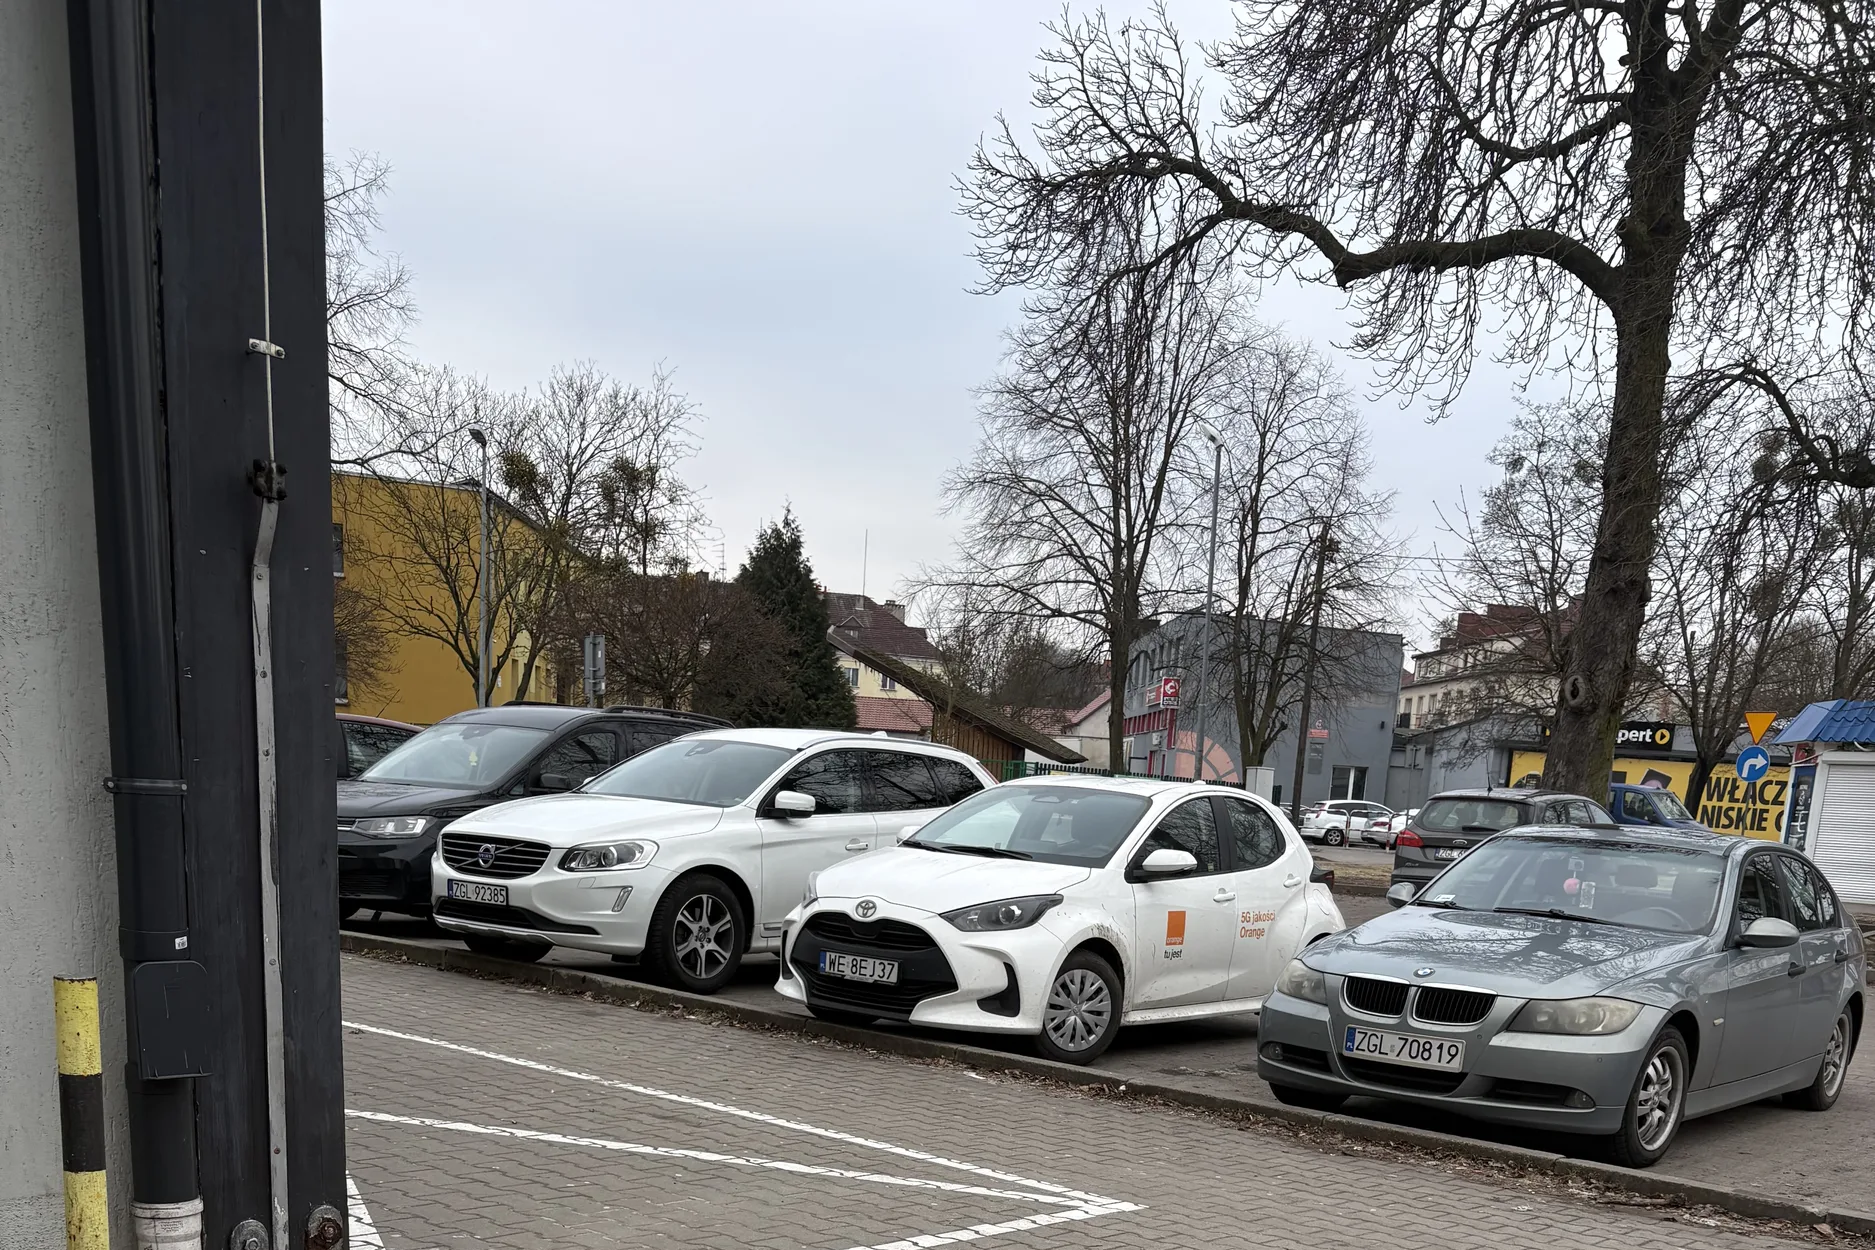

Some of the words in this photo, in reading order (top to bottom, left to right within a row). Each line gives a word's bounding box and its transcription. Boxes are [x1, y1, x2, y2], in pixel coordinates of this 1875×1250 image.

[1616, 729, 1652, 743] pert
[1700, 805, 1769, 831] NISKIE
[454, 882, 471, 899] ZGL
[475, 885, 506, 904] 92385
[1241, 911, 1251, 923] 5G
[1252, 910, 1276, 925] jakości
[1240, 926, 1265, 939] Orange
[1164, 950, 1171, 959] tu
[1170, 949, 1182, 960] jest
[829, 954, 846, 973] WE
[850, 958, 895, 980] 8EJ37
[1355, 1031, 1388, 1055] ZGL
[1396, 1037, 1459, 1064] 70819
